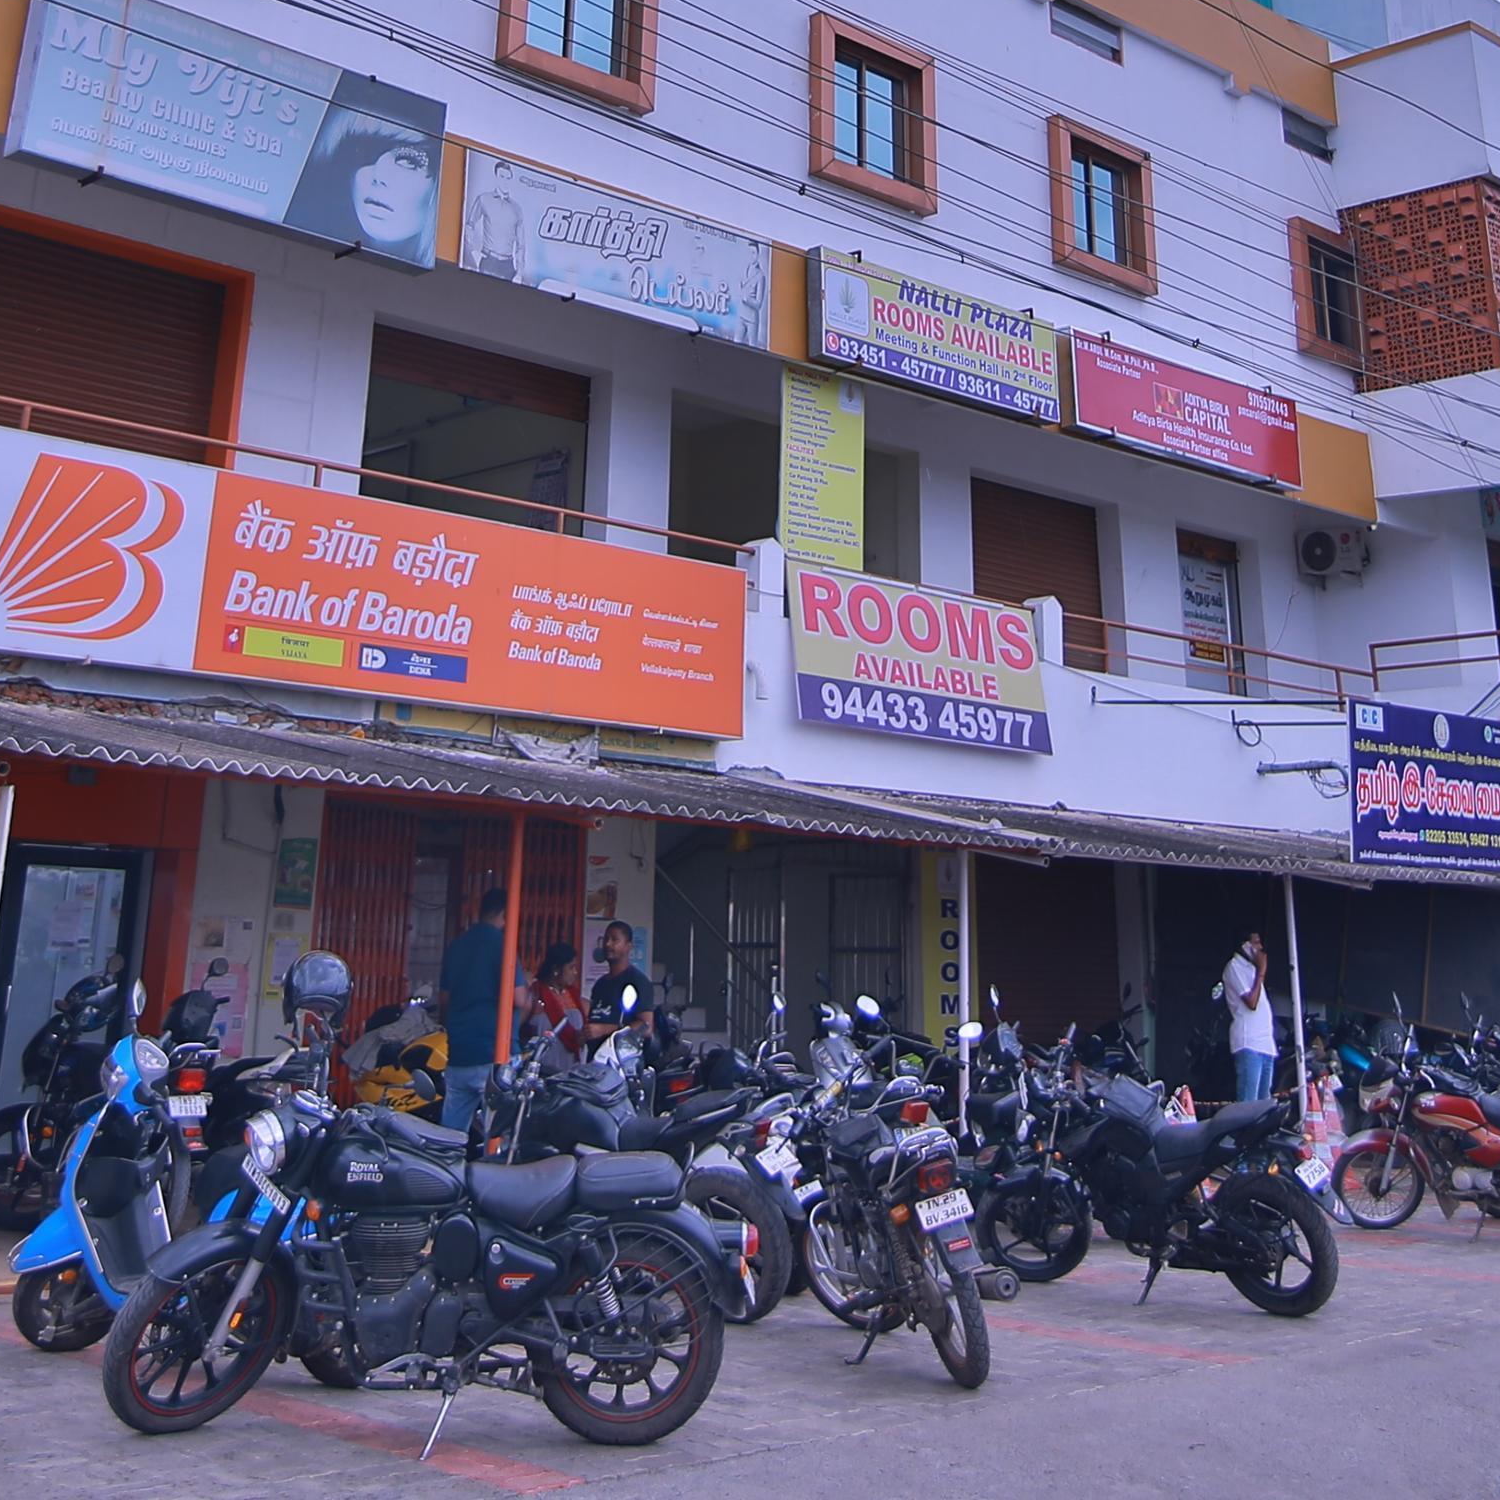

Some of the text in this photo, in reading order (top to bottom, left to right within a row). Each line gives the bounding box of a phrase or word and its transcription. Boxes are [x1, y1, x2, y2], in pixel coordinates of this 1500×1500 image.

[60, 67, 144, 112] Beauty
[222, 122, 236, 141] &
[172, 132, 180, 144] &
[183, 137, 227, 158] LADIES
[140, 145, 192, 174] அழகு
[195, 162, 268, 194] நிலையம்
[538, 205, 669, 263] கார்த்தி
[629, 262, 732, 315] டெய்லர்
[899, 279, 1033, 342] NALLI PLAZA
[871, 296, 1053, 376] ROOMS AVAILABLE
[839, 332, 1054, 419] 93451 45777 93611 45777
[875, 328, 918, 353] Meeting
[921, 341, 930, 353] &
[933, 345, 976, 372] Function
[979, 359, 999, 377] Hall
[1001, 364, 1011, 378] in
[1029, 374, 1053, 393] Floor
[1096, 358, 1141, 379] Associate Partner
[1184, 392, 1230, 417] ADITYA BIRLA
[1184, 406, 1232, 435] CAPITAL
[1132, 410, 1155, 427] Aditya
[1156, 416, 1173, 431] Birla
[1173, 422, 1196, 438] Health
[1198, 429, 1229, 449] Insurance
[1163, 432, 1228, 462] Associate Partner office
[234, 499, 480, 588] बैंक ऑफ़ बड़ौदा
[224, 569, 473, 645] Bank of Baroda
[510, 608, 533, 631] बैंक
[565, 620, 600, 643] बड़ौदा
[798, 572, 1036, 672] ROOMS
[280, 648, 308, 660] VIJAYA
[408, 665, 432, 677] DENA
[508, 641, 602, 671] Bank of Baroda
[687, 669, 714, 682] Branch
[853, 652, 1000, 701] AVAILABLE
[820, 681, 1035, 749] 94433 45977
[1357, 760, 1399, 825] தமிழ்
[940, 899, 960, 1047] ROOMS
[347, 1172, 384, 1183] ENFIELD
[350, 1161, 380, 1172] ROYAL
[925, 1193, 957, 1210] TN.29
[925, 1204, 969, 1226] BV.3416
